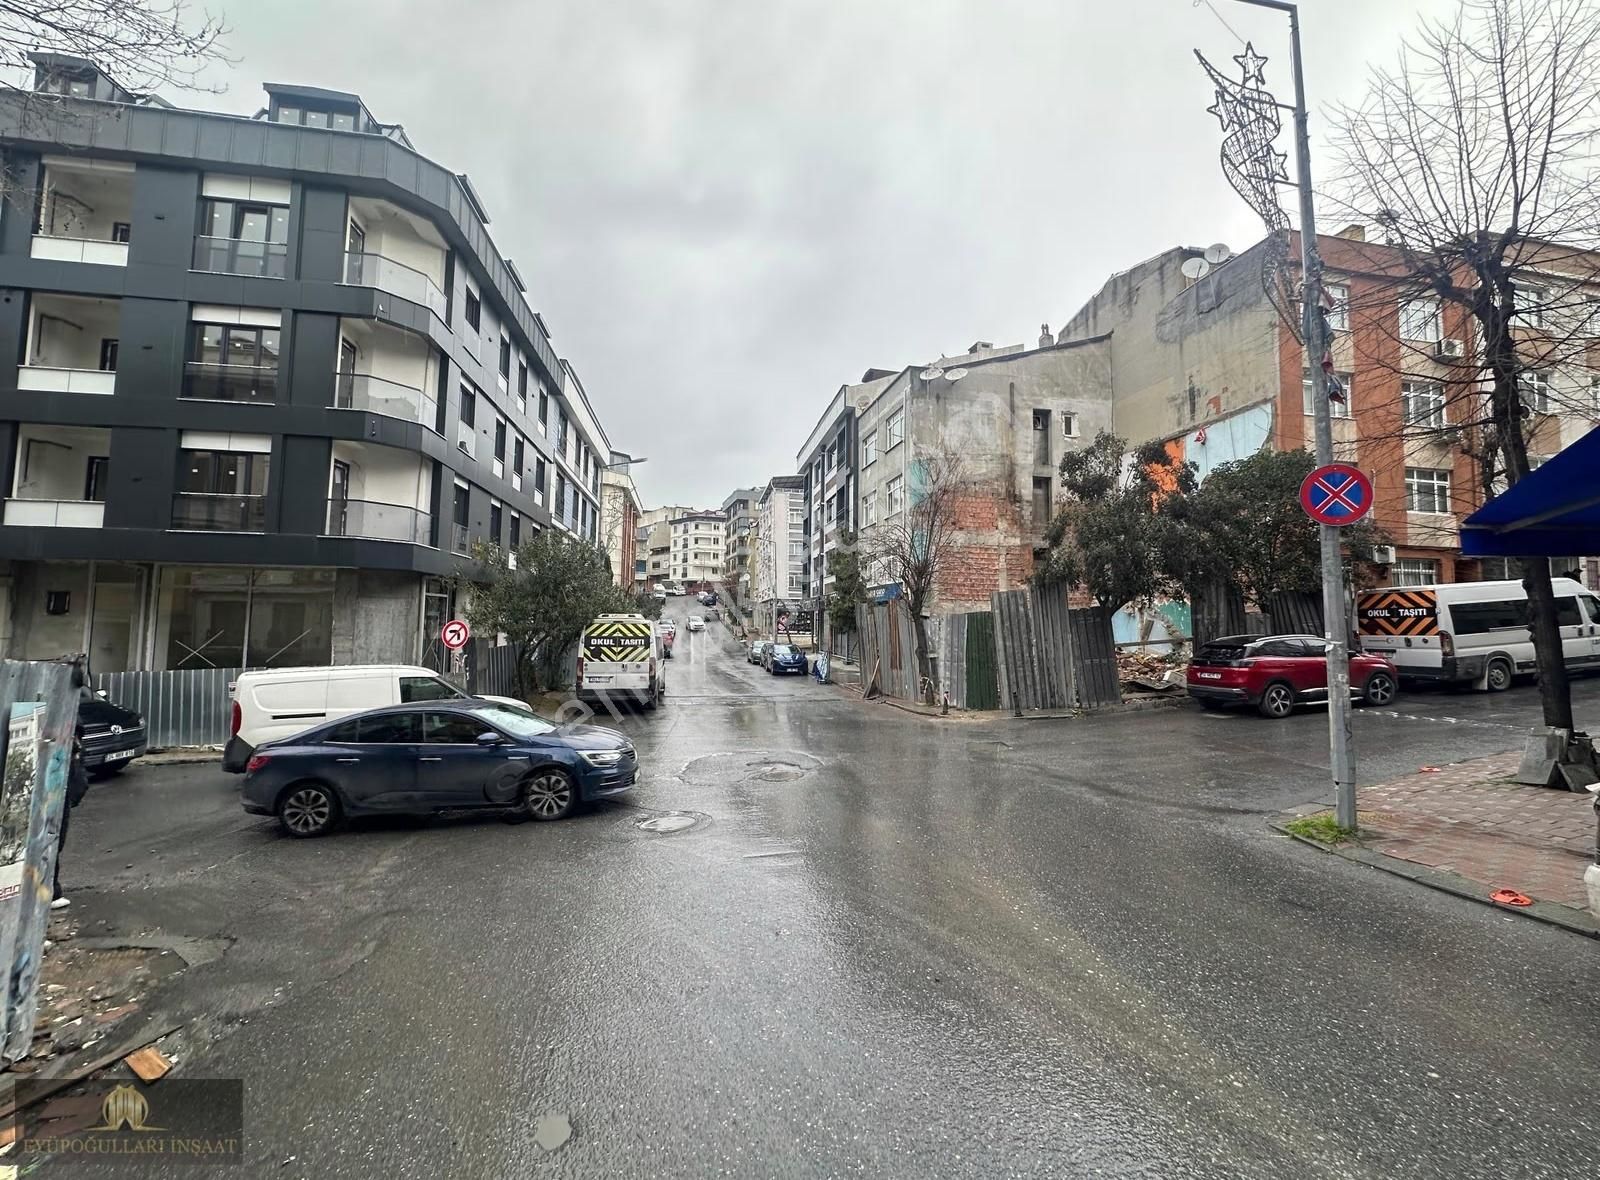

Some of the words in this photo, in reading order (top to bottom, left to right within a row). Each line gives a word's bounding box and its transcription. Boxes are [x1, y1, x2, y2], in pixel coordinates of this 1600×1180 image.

[1367, 609, 1391, 617] OKUL
[1398, 607, 1427, 618] TAŞITI
[591, 638, 615, 646] OKUL
